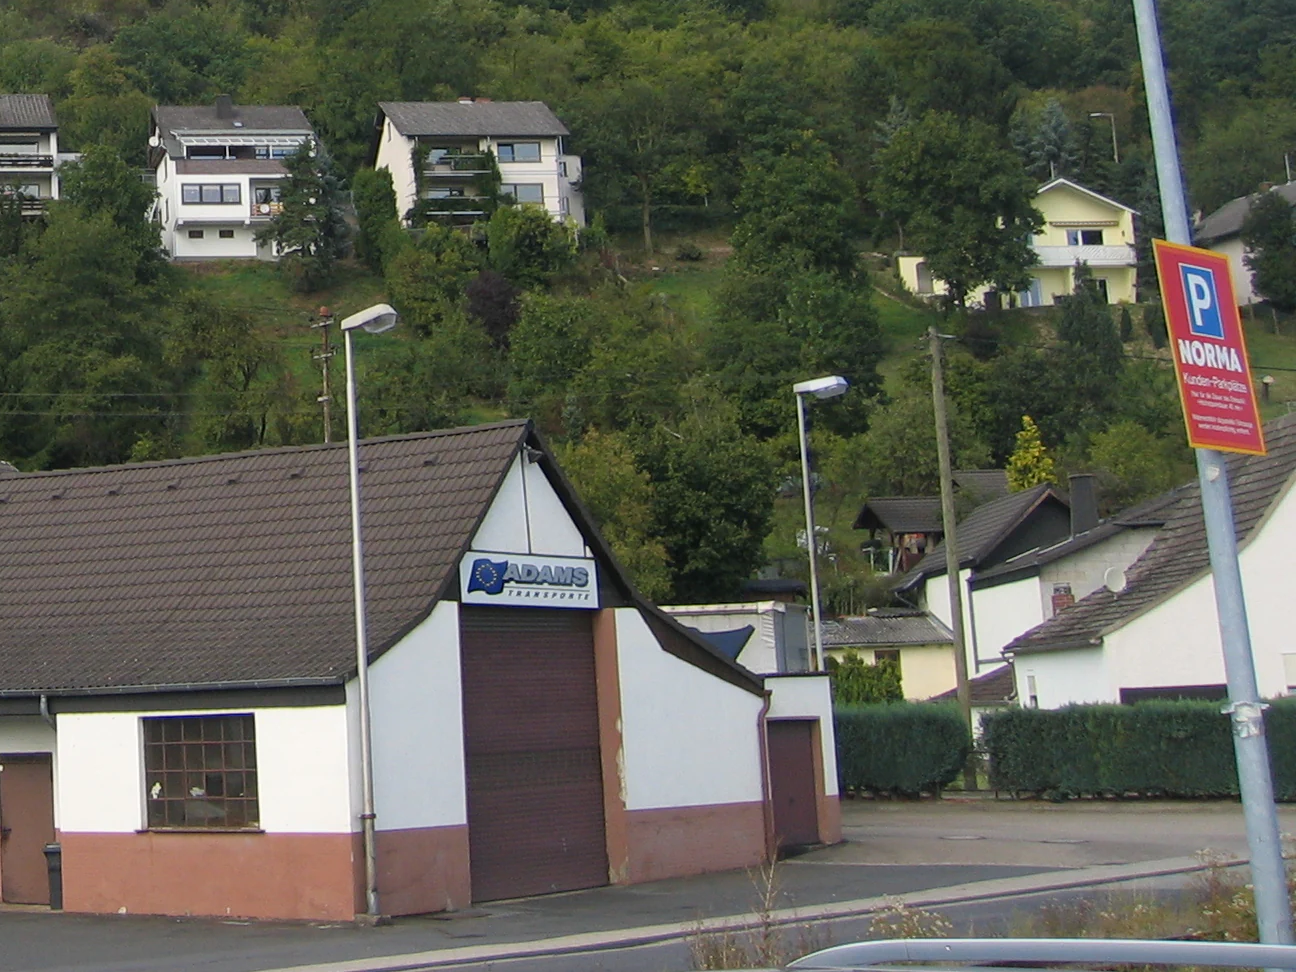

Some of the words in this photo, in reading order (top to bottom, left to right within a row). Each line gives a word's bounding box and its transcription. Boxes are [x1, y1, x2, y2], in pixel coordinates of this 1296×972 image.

[1187, 273, 1212, 327] P
[1178, 339, 1243, 373] NORMA
[503, 563, 589, 587] ADAMS
[508, 590, 591, 600] TRANSPORTE
